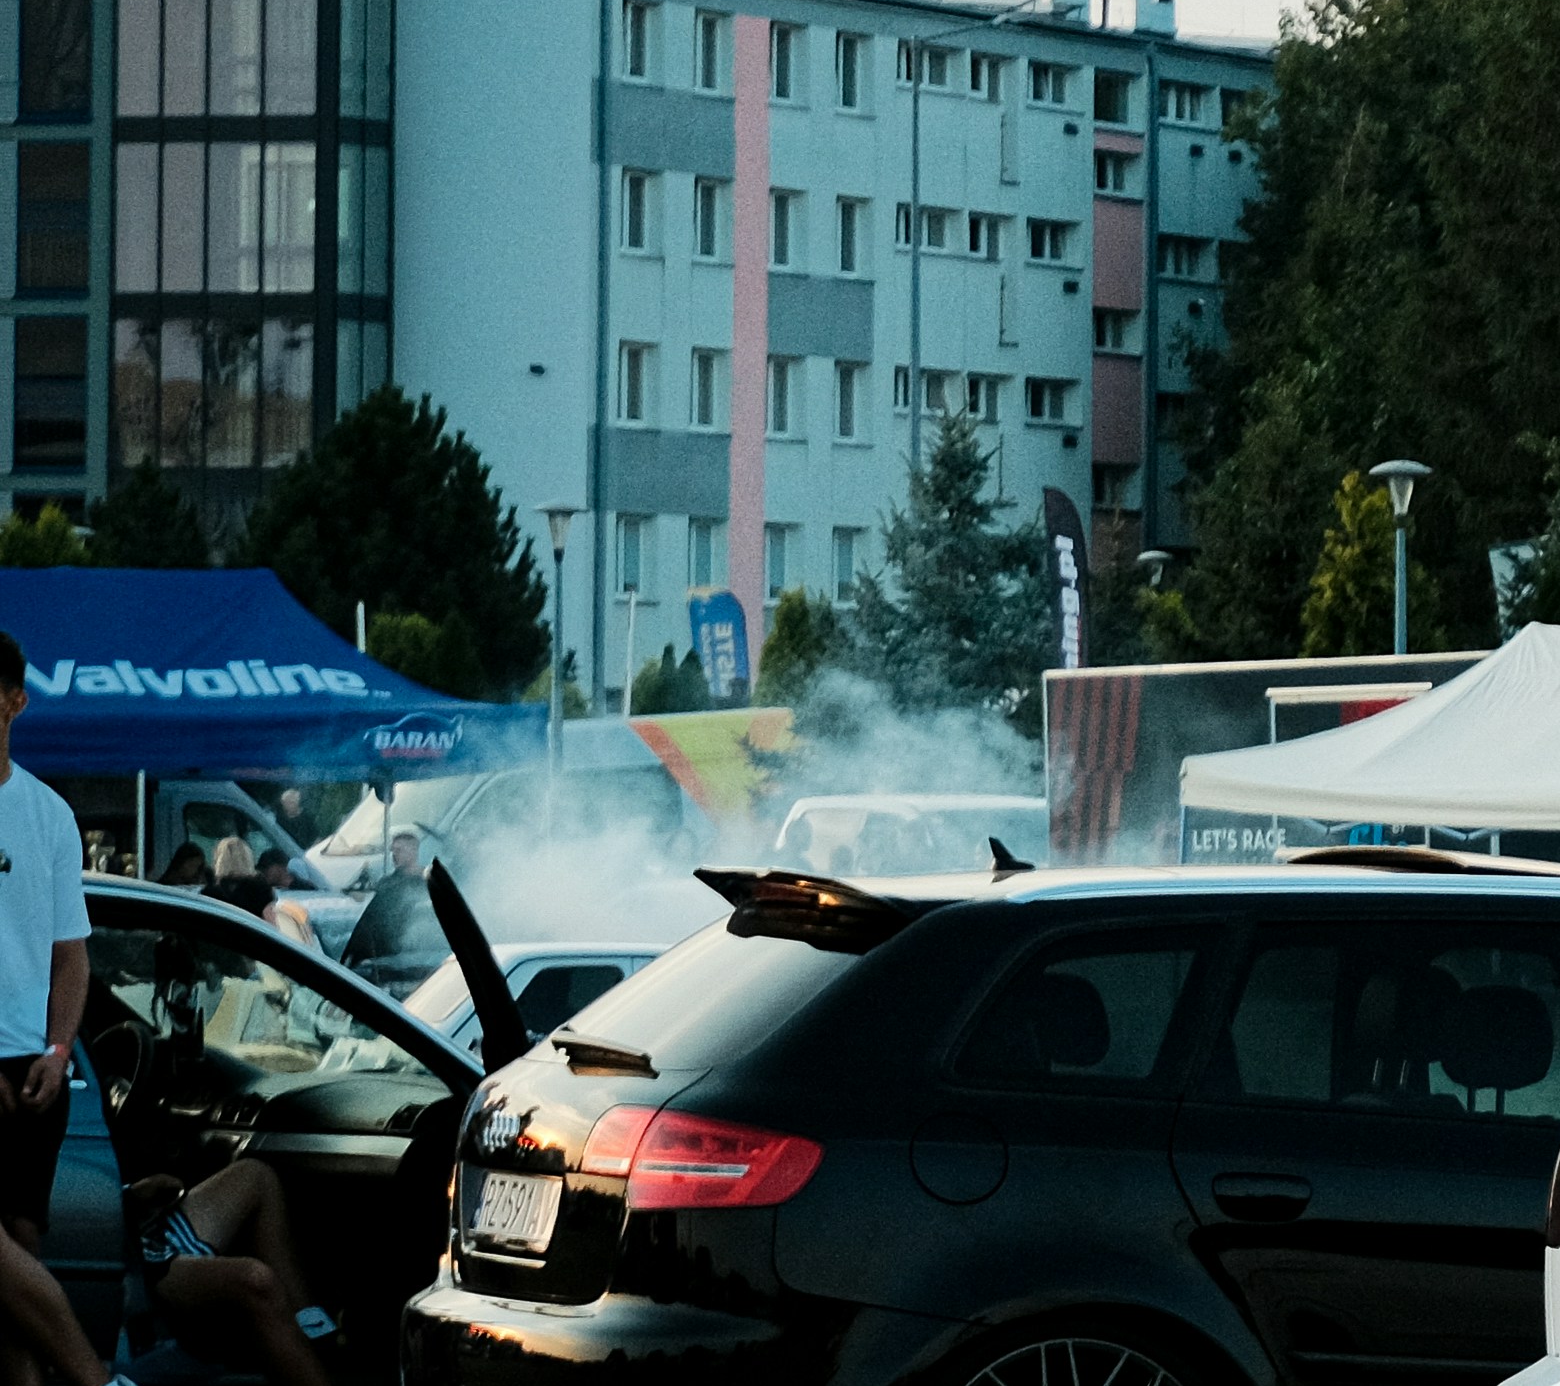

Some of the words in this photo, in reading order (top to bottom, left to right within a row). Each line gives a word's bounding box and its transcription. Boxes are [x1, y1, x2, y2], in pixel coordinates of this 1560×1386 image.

[26, 659, 367, 698] Valvoline
[375, 730, 455, 751] BARAN
[1192, 828, 1237, 851] LET'S
